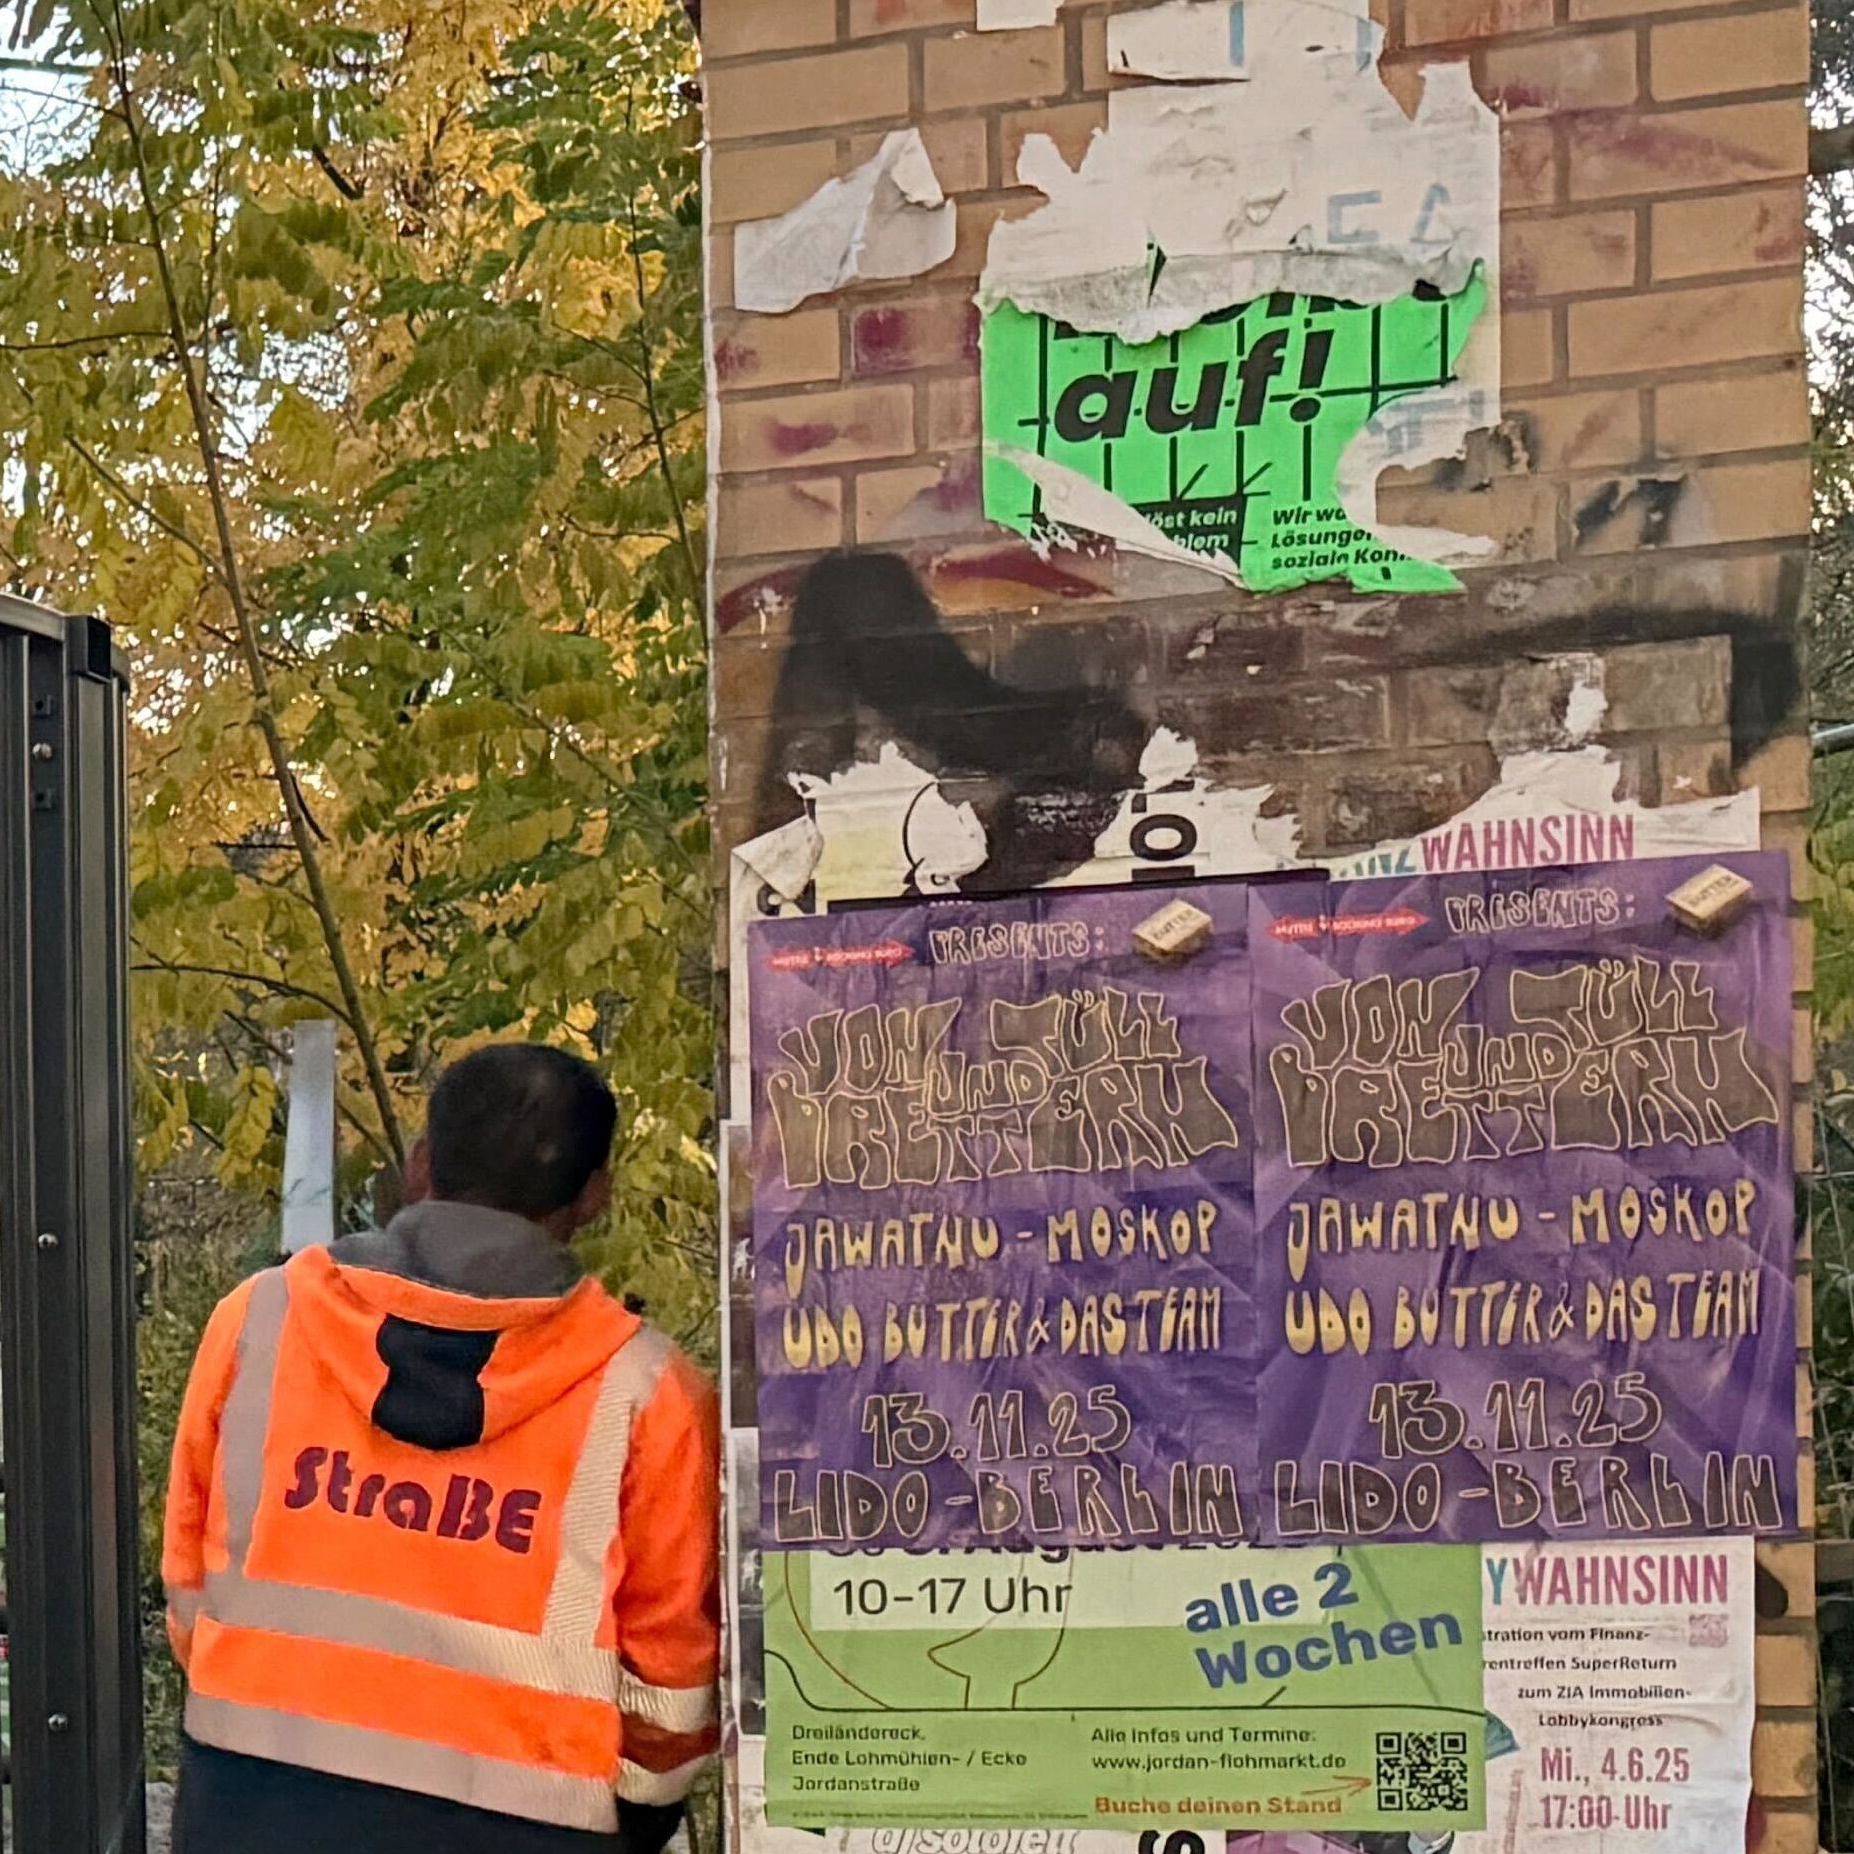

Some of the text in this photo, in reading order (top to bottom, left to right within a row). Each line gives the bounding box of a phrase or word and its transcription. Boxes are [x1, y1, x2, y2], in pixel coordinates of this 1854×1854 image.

[1054, 327, 1336, 443] auf!
[1272, 508, 1313, 526] Wir
[1571, 1178, 1756, 1245] MOSKOP
[1047, 1200, 1218, 1263] MOSKOP
[783, 1305, 863, 1370] UDO
[884, 1297, 1023, 1364] BUTTER
[1061, 1296, 1126, 1356] DAS
[1135, 1286, 1221, 1353] TEAM
[1285, 1288, 1370, 1356] UDO
[1394, 1280, 1541, 1351] BUTTER
[1585, 1274, 1657, 1343] DAS
[1668, 1268, 1761, 1340] TEAM
[862, 1384, 1131, 1469] 13.11.25
[1368, 1372, 1663, 1460] 13.11.25
[984, 1576, 1073, 1615] Uhr
[1185, 1562, 1359, 1633] alle 2
[1195, 1612, 1463, 1689] Wochen
[1548, 1629, 1586, 1642] vom
[1590, 1628, 1651, 1642] Finanz-
[1571, 1655, 1678, 1672] SuperReturn
[1518, 1687, 1551, 1699] zum
[1590, 1684, 1693, 1700] Immobilien-
[1091, 1726, 1317, 1744] Alle Infos und Termine:
[1538, 1713, 1664, 1732] Lobbykongress
[792, 1749, 839, 1767] Ende
[844, 1749, 961, 1768] Lohmühlen-
[981, 1750, 1028, 1768] Ecke
[1091, 1751, 1347, 1774] www.jordan-flohmarkt.de
[1601, 1746, 1691, 1784] 4.6.25
[792, 1775, 922, 1793] Jordanstraße
[1095, 1796, 1172, 1816] Buche
[1177, 1795, 1262, 1815] deinen
[1267, 1794, 1343, 1815] Stand
[1624, 1793, 1674, 1830] Uhr
